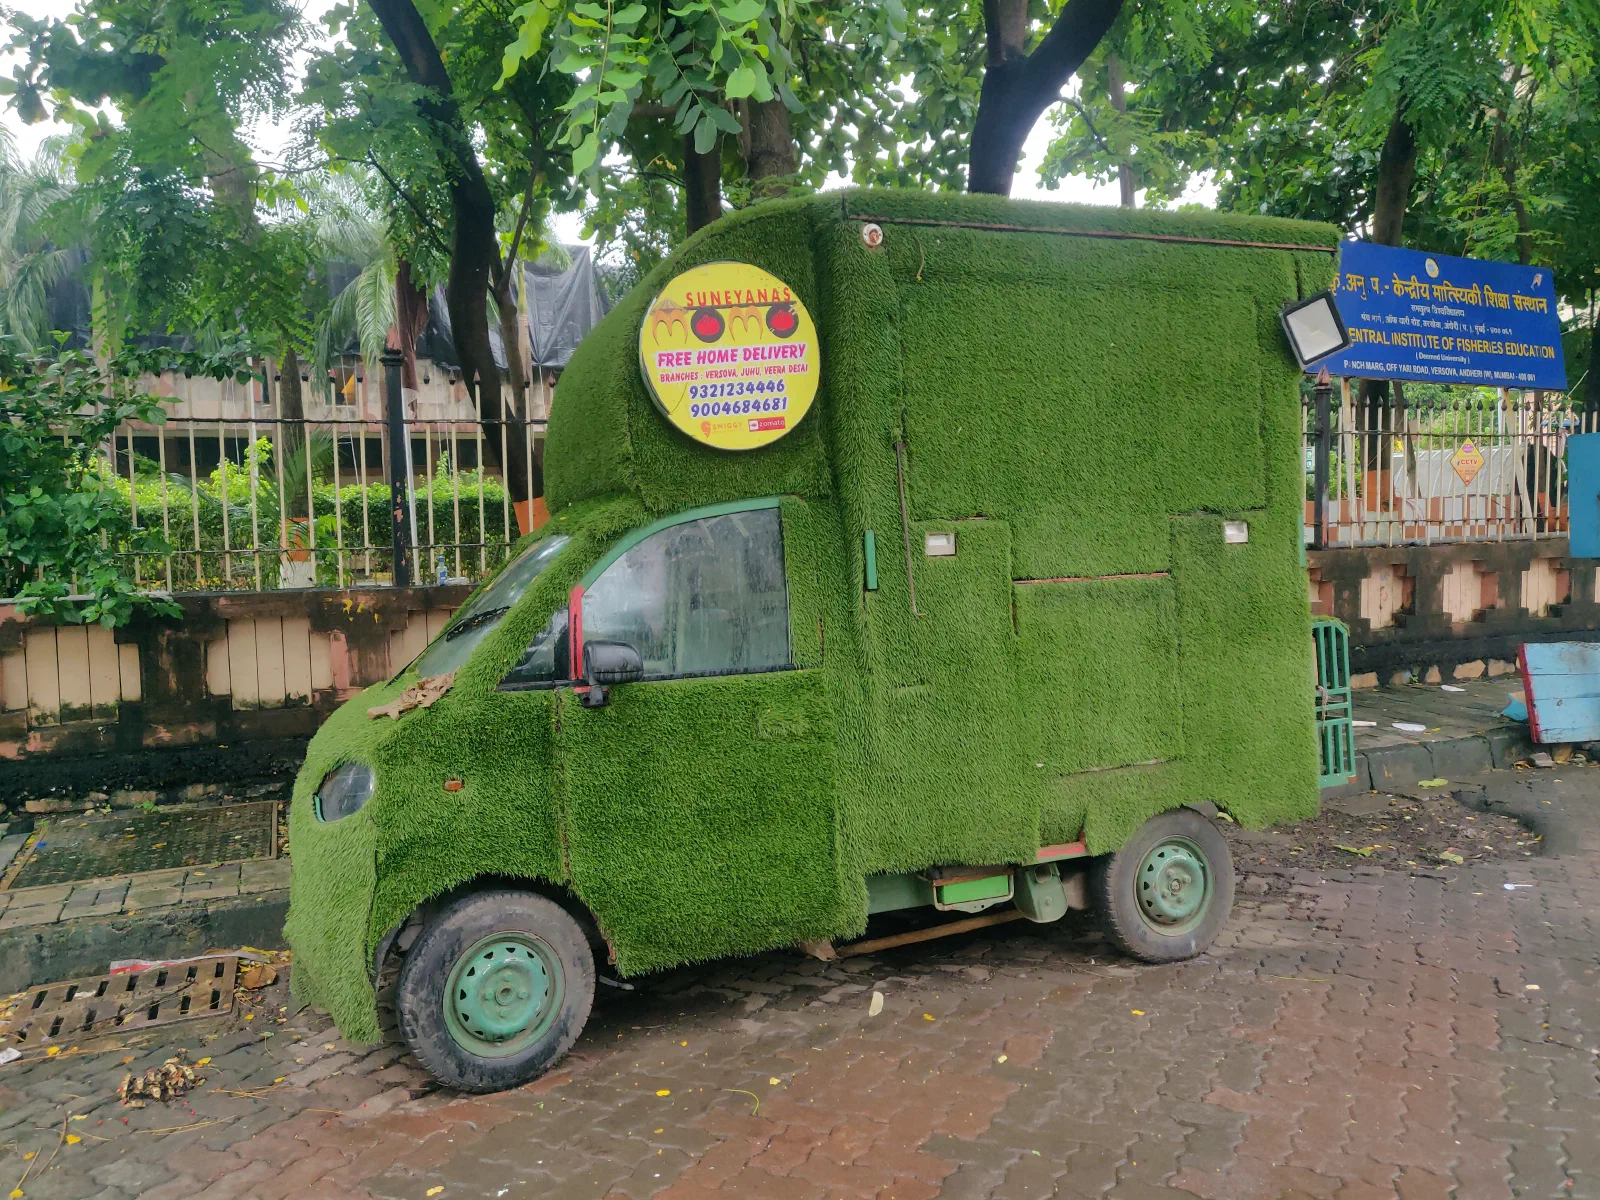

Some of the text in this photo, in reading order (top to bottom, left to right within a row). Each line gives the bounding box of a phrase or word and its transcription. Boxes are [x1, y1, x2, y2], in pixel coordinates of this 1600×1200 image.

[686, 286, 791, 307] SUNEYANAS
[1392, 272, 1430, 300] केन्द्रीय
[1484, 284, 1511, 309] शिक्षा
[1512, 290, 1548, 314] संस्थान
[1348, 327, 1555, 359] ENTRAL INSTITUTE OF FISHERIES EDUCATION
[658, 343, 806, 368] FREE HOME DELIVERY
[1344, 359, 1365, 369] PNCH
[1386, 362, 1398, 372] OFF
[660, 371, 698, 383] BRANCHES
[764, 364, 785, 375] VEERA
[788, 363, 808, 374] DESAI
[690, 379, 785, 400] 9321234446
[691, 397, 787, 418] 9004684681
[712, 421, 743, 430] SWIGGY
